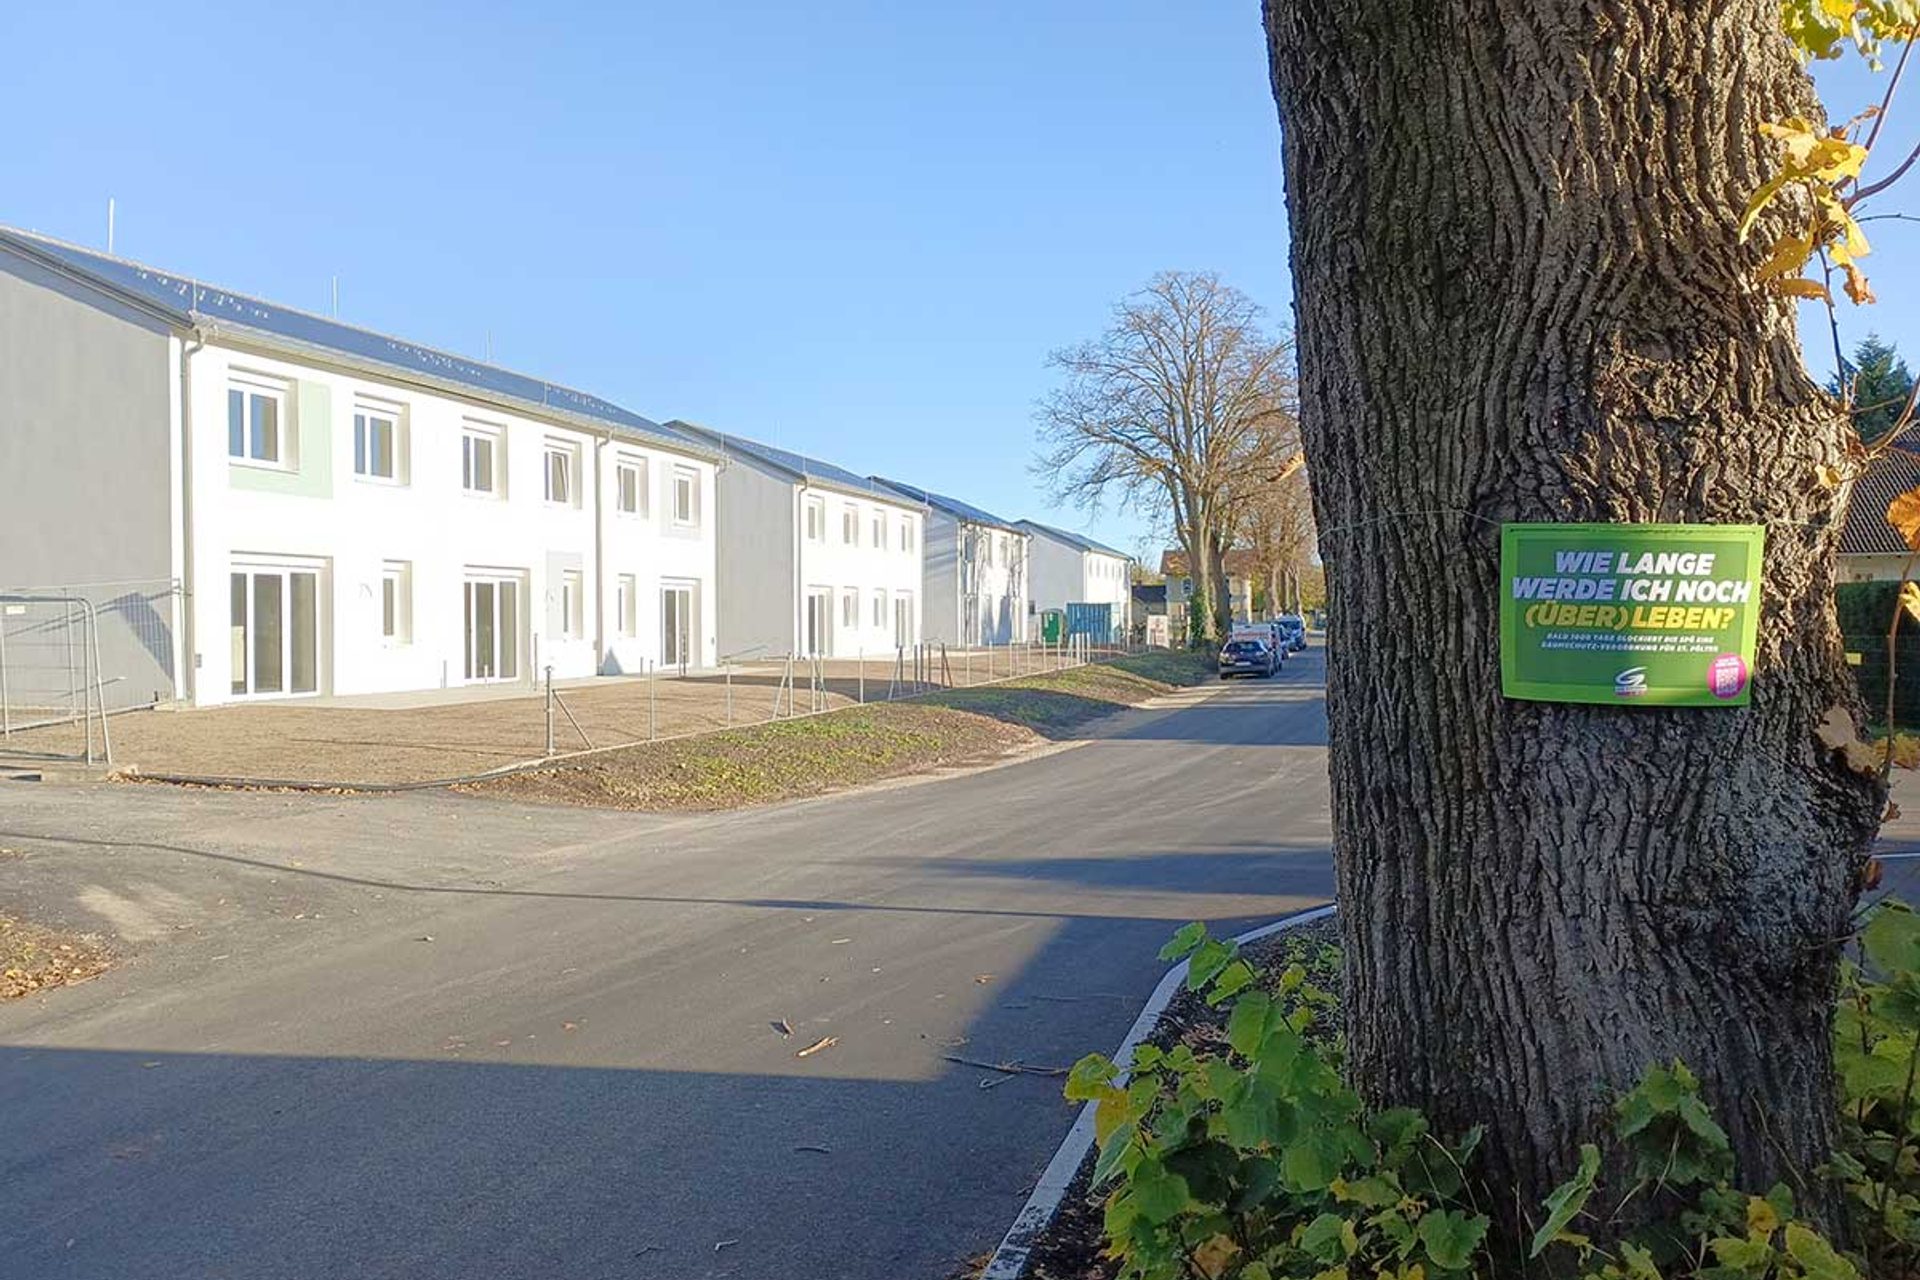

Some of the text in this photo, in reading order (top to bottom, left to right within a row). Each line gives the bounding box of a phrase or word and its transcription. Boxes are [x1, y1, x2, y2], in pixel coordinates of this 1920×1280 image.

[1556, 552, 1715, 576] WIE LANGE
[1513, 578, 1752, 603] WERDE ICH NOCH
